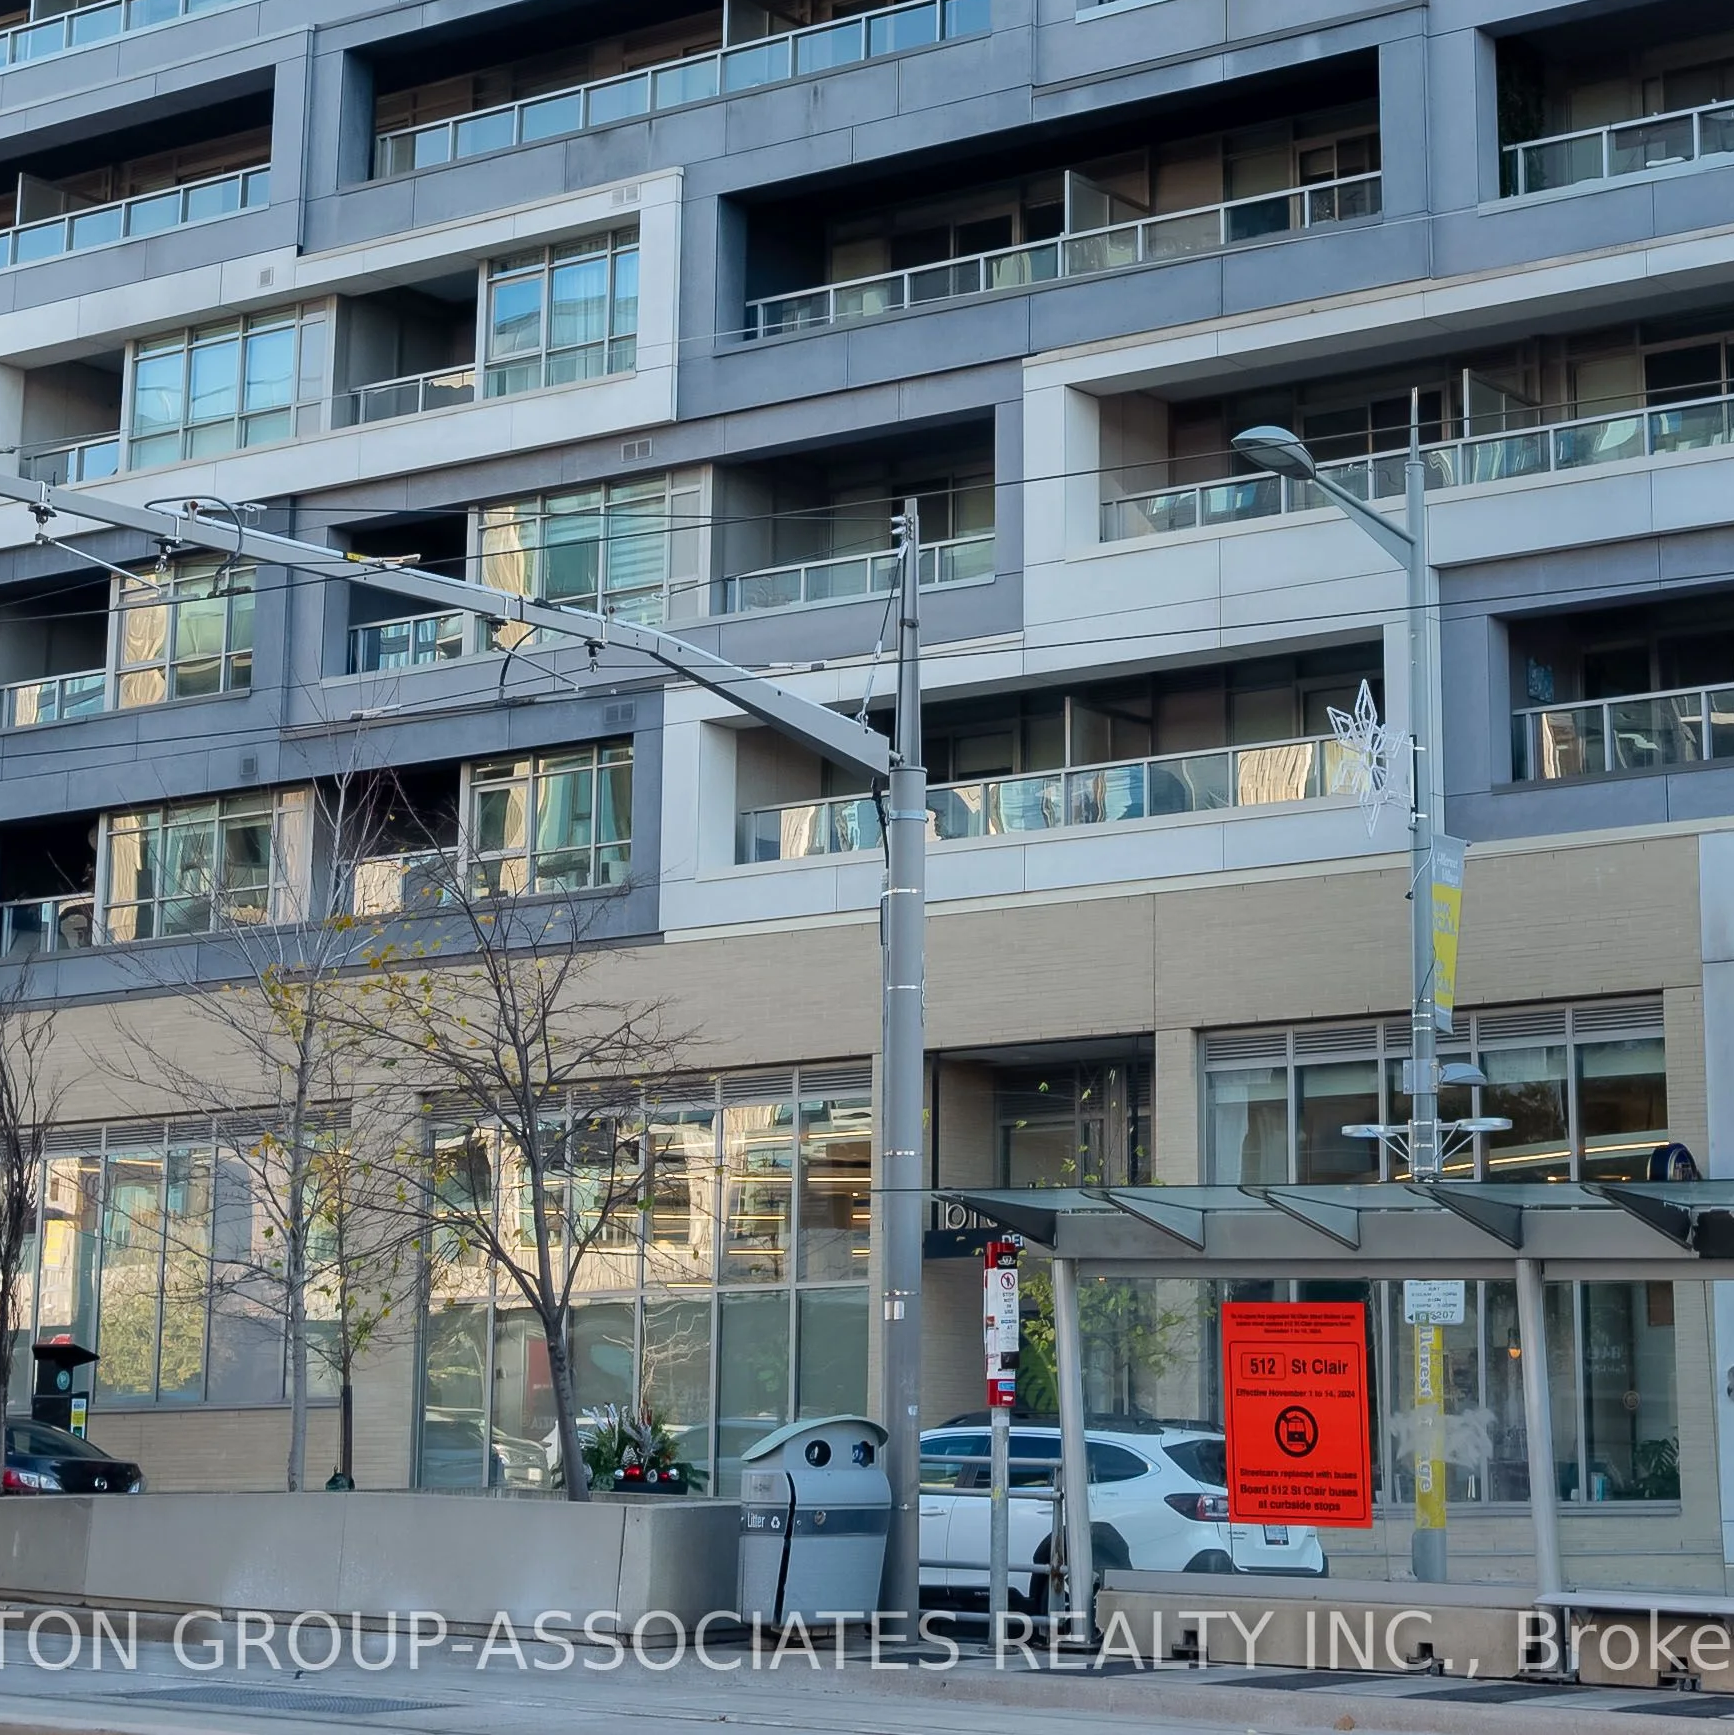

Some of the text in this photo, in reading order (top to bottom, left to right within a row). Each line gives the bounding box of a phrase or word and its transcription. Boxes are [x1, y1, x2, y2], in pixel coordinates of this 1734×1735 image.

[1250, 1357, 1349, 1375] 512 St Clair
[1235, 1388, 1267, 1397] Effective
[1268, 1388, 1307, 1398] November
[1314, 1389, 1323, 1397] to
[1240, 1483, 1358, 1497] Board 512 St Clair buses
[1269, 1500, 1311, 1511] curbside
[1314, 1502, 1341, 1513] stops
[747, 1512, 766, 1528] Litter
